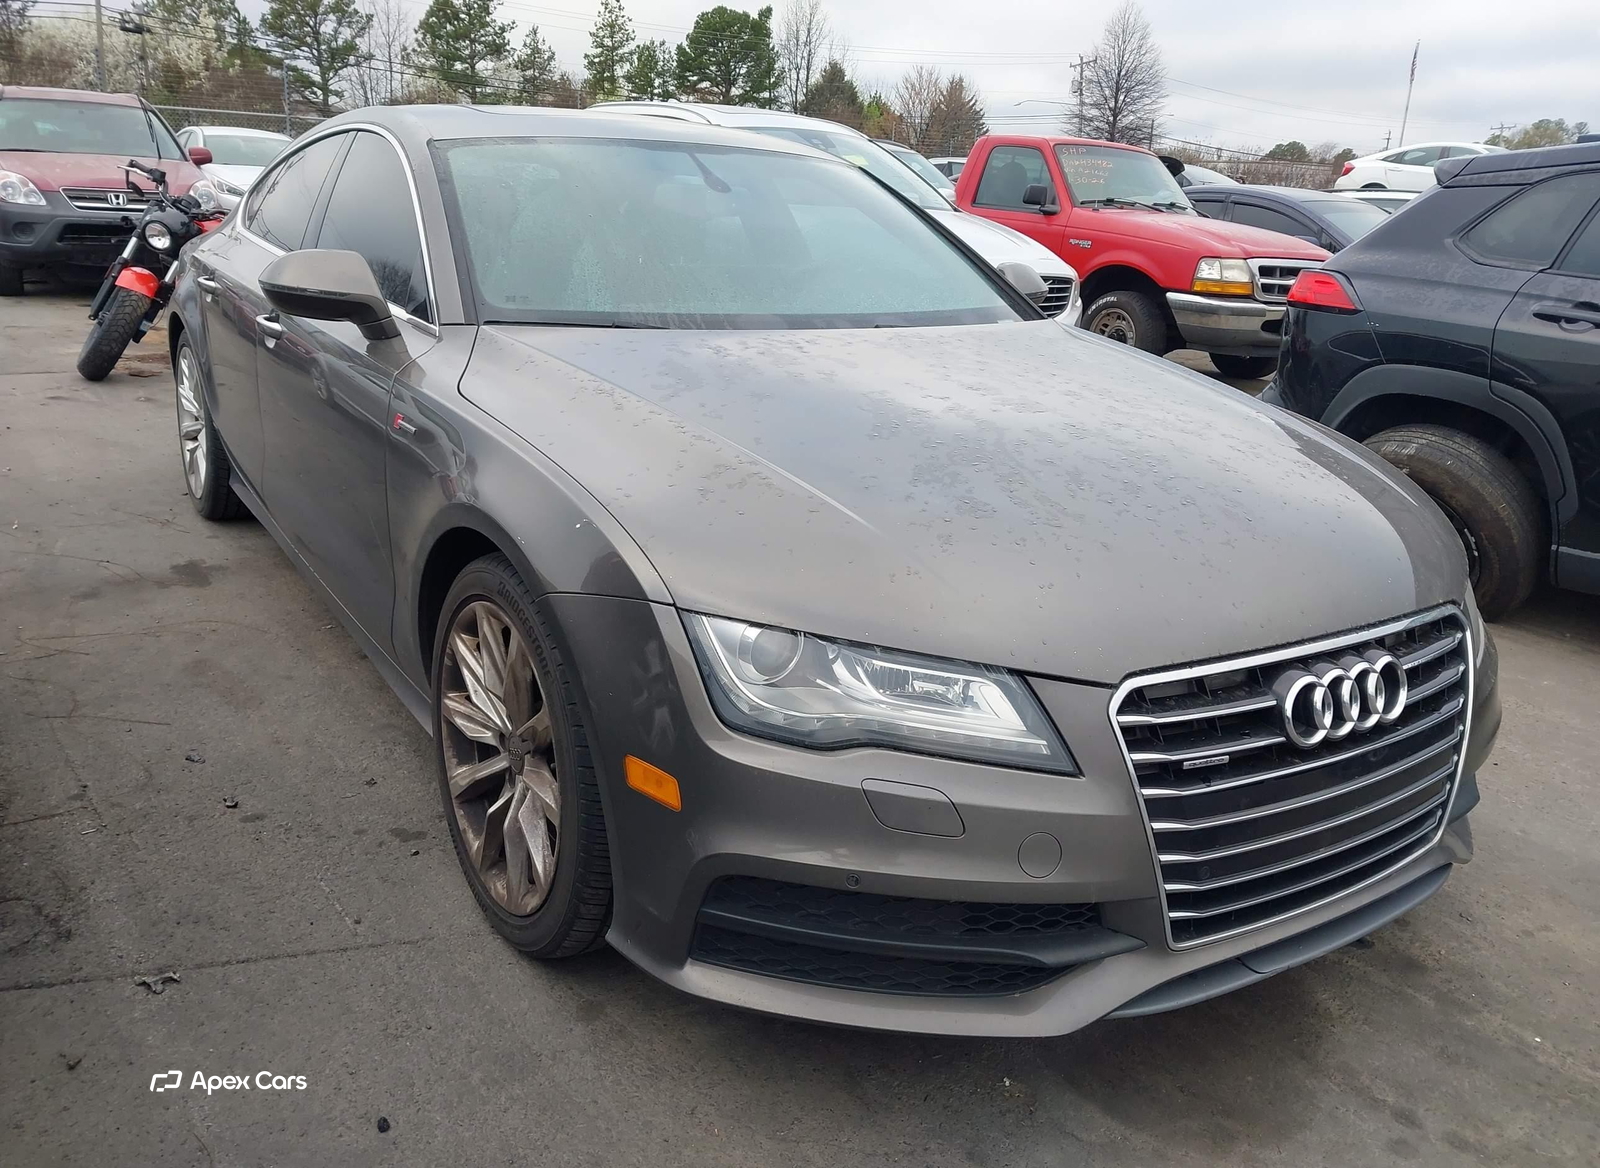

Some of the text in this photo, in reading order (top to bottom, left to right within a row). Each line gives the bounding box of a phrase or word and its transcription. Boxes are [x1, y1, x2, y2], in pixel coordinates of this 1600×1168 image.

[1062, 147, 1087, 157] SHP
[1087, 296, 1118, 315] UNIROYAL
[496, 581, 553, 680] BRIDGESTONE
[1188, 757, 1225, 768] quattro
